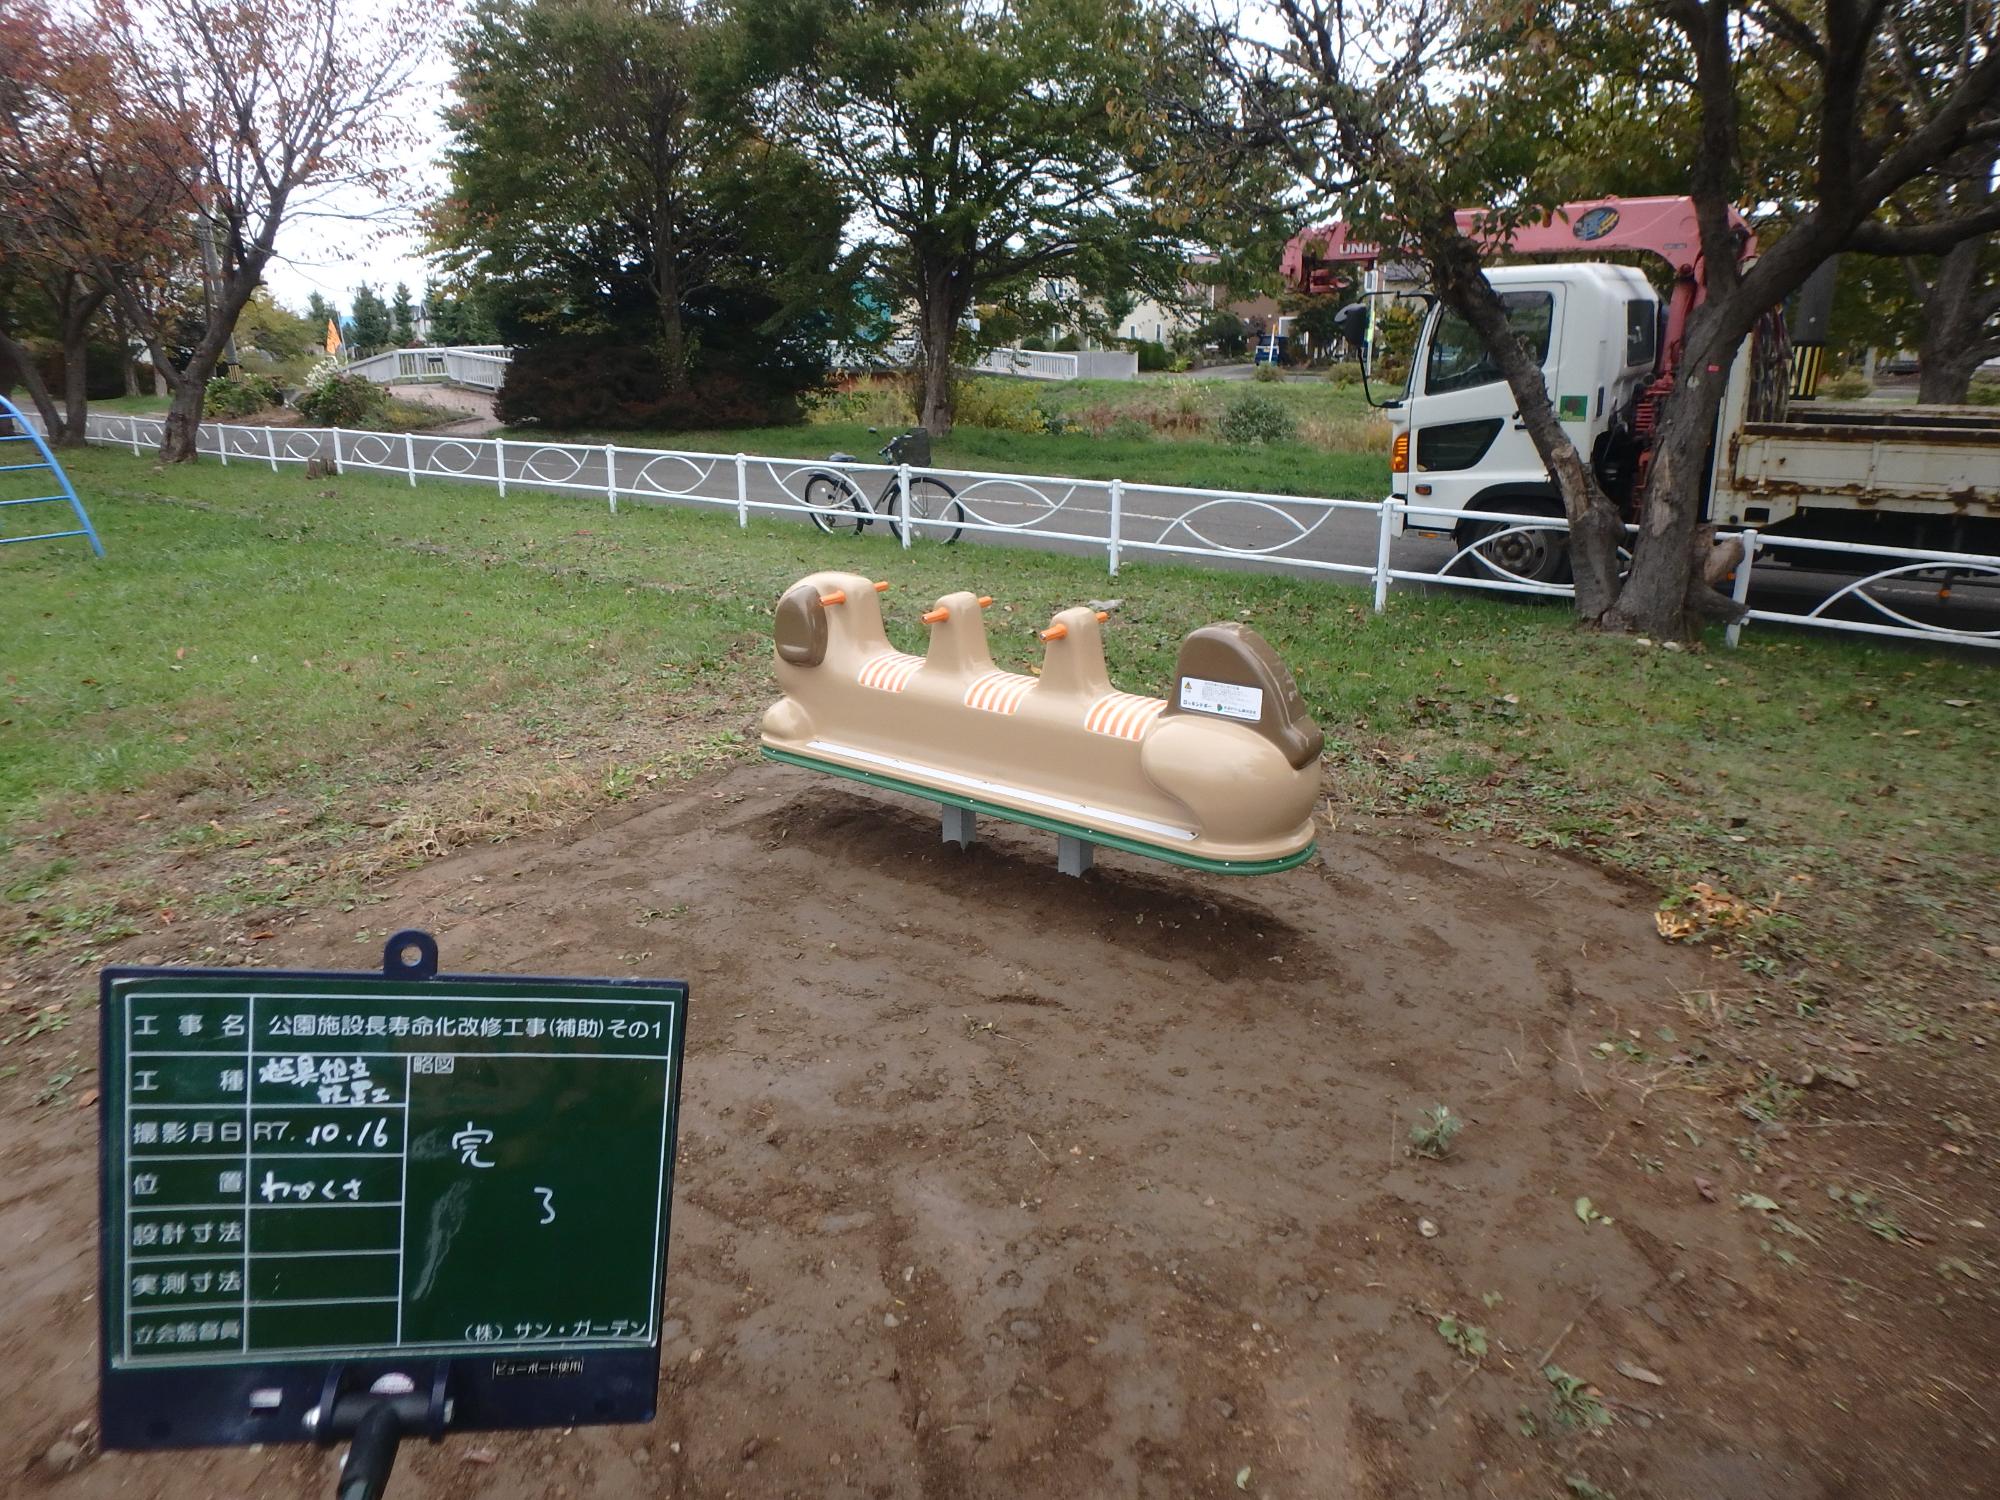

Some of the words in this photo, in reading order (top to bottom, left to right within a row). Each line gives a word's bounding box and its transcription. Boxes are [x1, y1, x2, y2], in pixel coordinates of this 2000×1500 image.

[134, 1014, 245, 1037] 工事名
[413, 1056, 455, 1074] 略図
[133, 1121, 242, 1144] 撮影月日
[452, 1121, 496, 1168] 完
[533, 1186, 557, 1225] 3
[132, 1220, 242, 1246] 設計寸法
[131, 1269, 242, 1297] 実測寸法
[133, 1319, 241, 1345] 立会監督員
